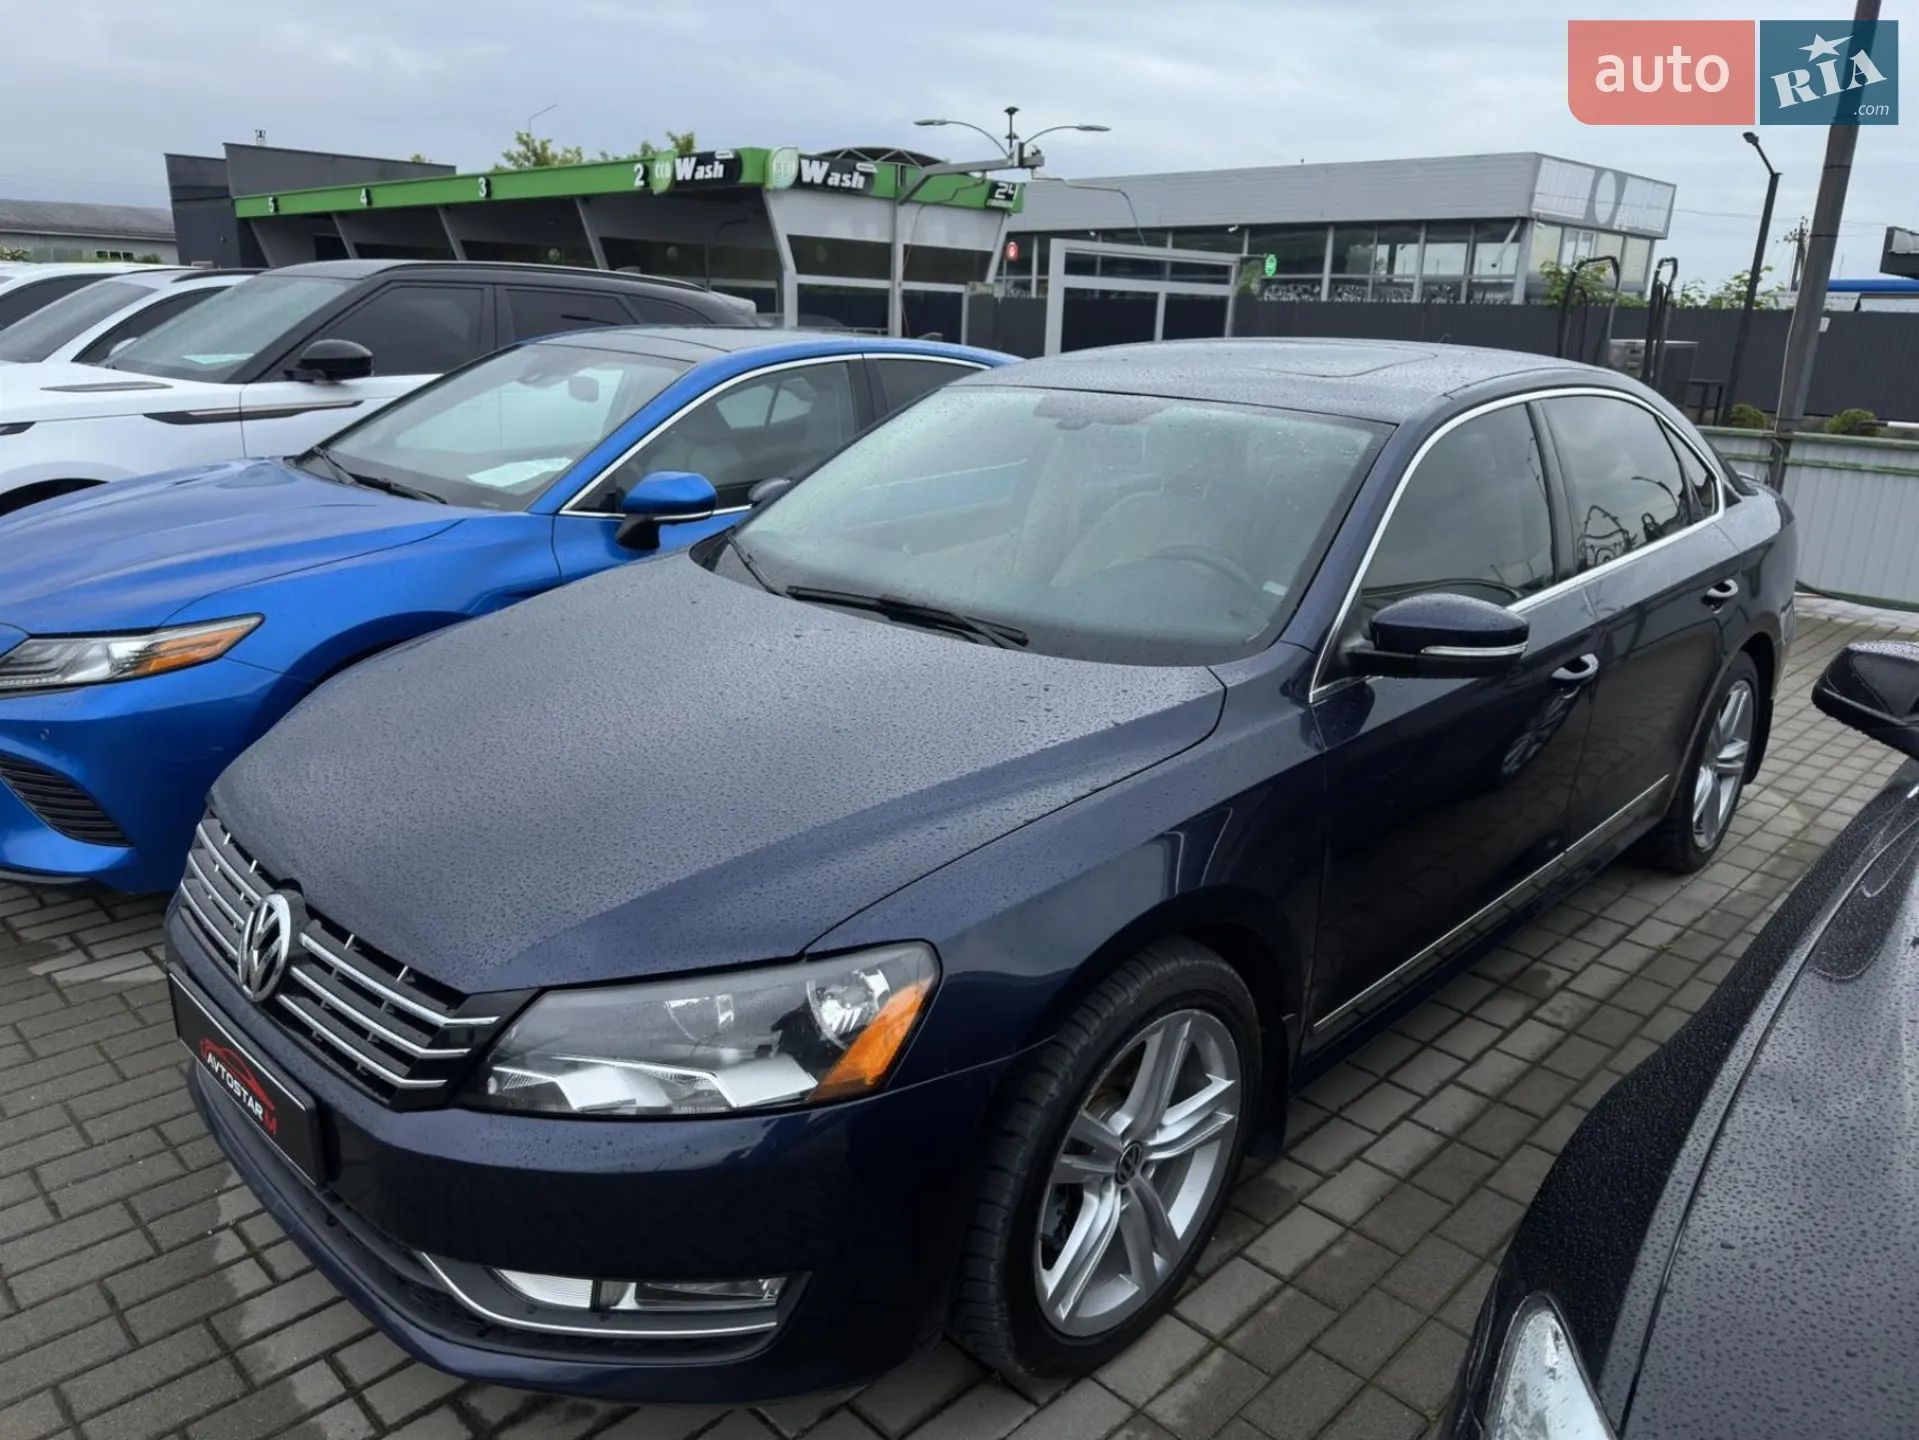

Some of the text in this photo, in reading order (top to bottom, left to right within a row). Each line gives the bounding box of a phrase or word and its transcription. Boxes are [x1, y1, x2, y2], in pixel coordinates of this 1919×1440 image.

[633, 163, 645, 187] 2
[675, 156, 725, 181] Wash
[801, 159, 866, 189] Wash
[360, 187, 368, 207] 4
[478, 176, 487, 198] 3
